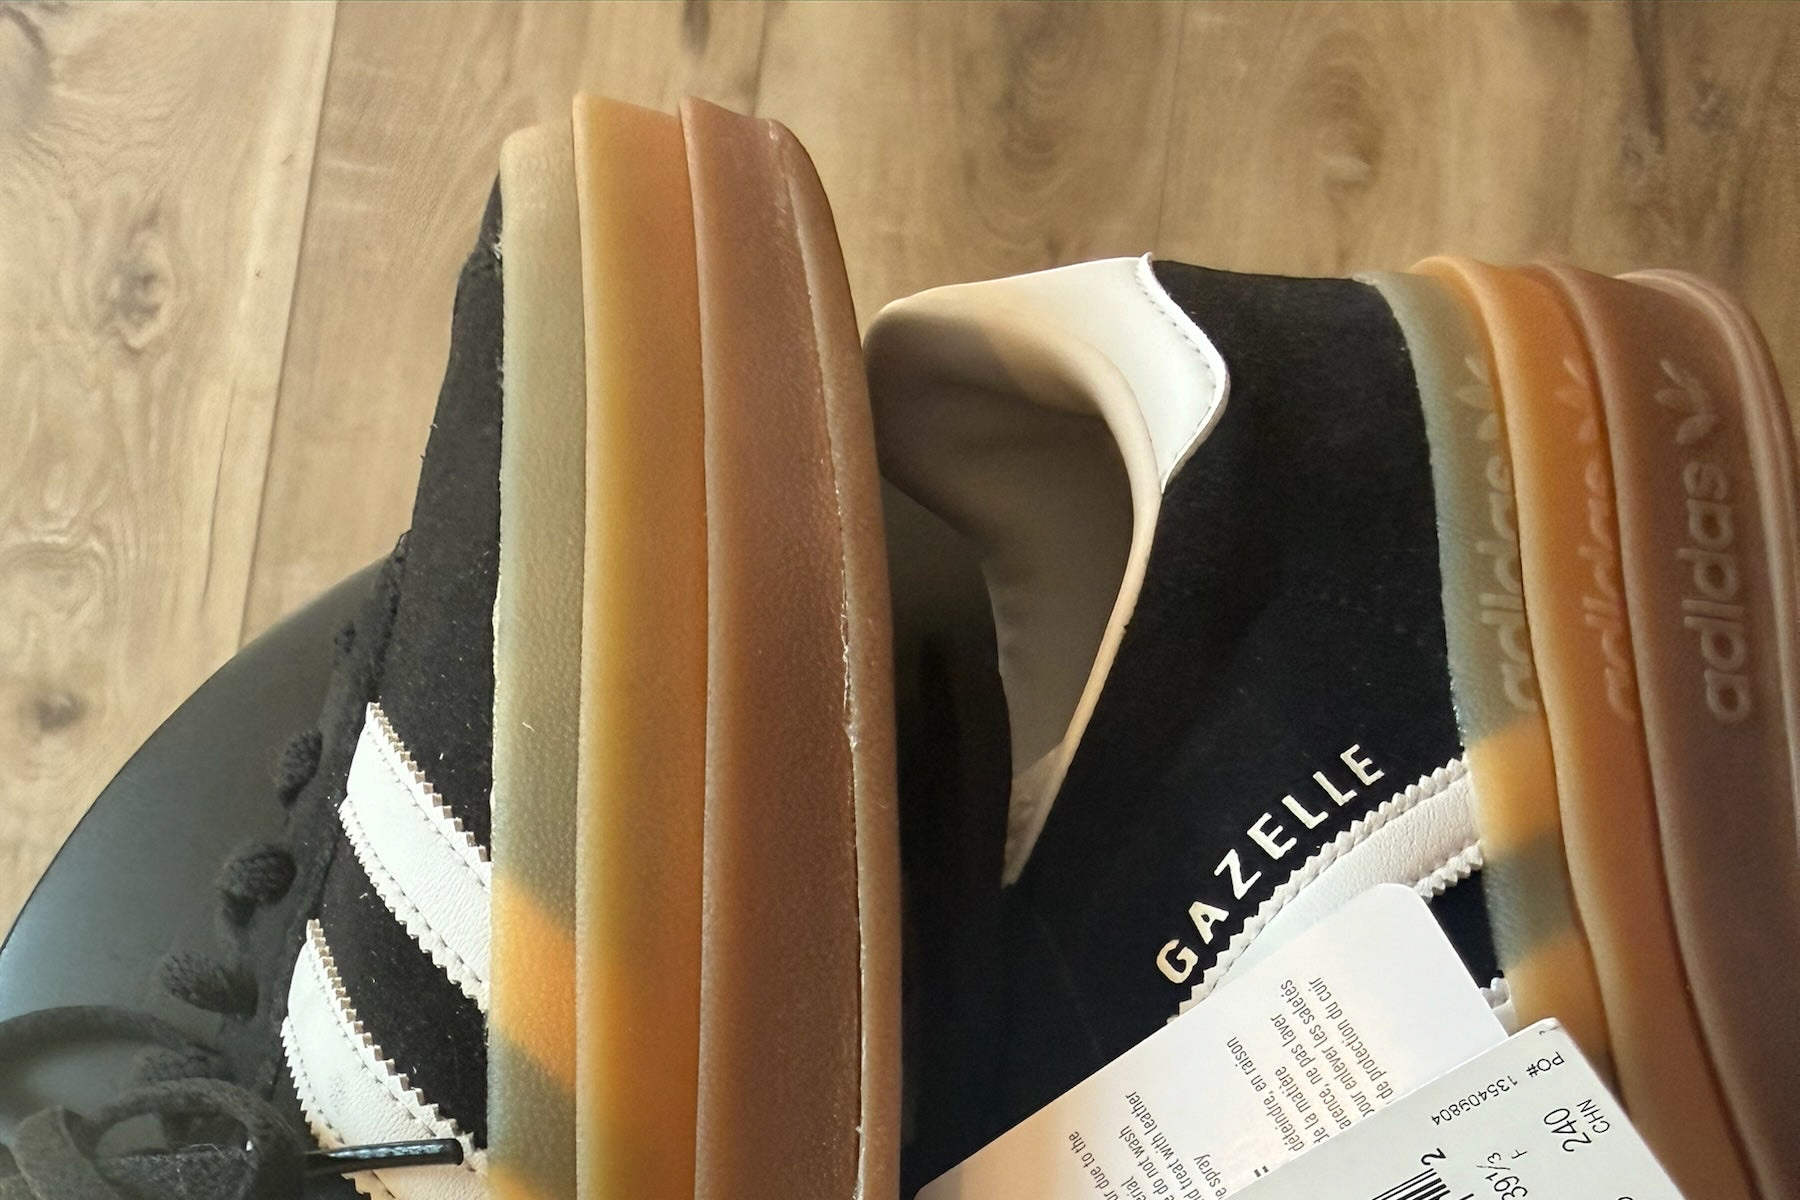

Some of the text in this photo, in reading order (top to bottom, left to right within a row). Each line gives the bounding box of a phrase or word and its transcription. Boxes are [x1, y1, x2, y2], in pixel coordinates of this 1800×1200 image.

[1676, 461, 1751, 723] adidas
[1156, 743, 1385, 984] GAZELLE
[1280, 979, 1315, 1025] saletés
[1270, 1013, 1297, 1048] laver
[1308, 977, 1394, 1100] de protection du cuir
[1309, 1024, 1328, 1049] les
[1290, 1043, 1316, 1068] pas
[1321, 1045, 1358, 1091] enlever
[1274, 1066, 1311, 1113] matière
[1305, 1067, 1323, 1085] ne
[1431, 1051, 1565, 1126] PO# 135409804
[1226, 1036, 1305, 1152] déteindre, en raison
[1125, 1091, 1158, 1136] leather
[1304, 1112, 1319, 1130] la
[1543, 1108, 1593, 1153] 240
[1576, 1098, 1611, 1134] CHN
[1068, 1131, 1086, 1154] the
[1118, 1125, 1145, 1159] wash
[1150, 1132, 1175, 1161] with
[1420, 1147, 1447, 1166] 2
[1081, 1152, 1095, 1169] to
[1137, 1156, 1159, 1179] not
[1166, 1158, 1193, 1191] treat
[1193, 1154, 1221, 1188] spray
[1089, 1166, 1110, 1190] due
[1152, 1178, 1169, 1195] do
